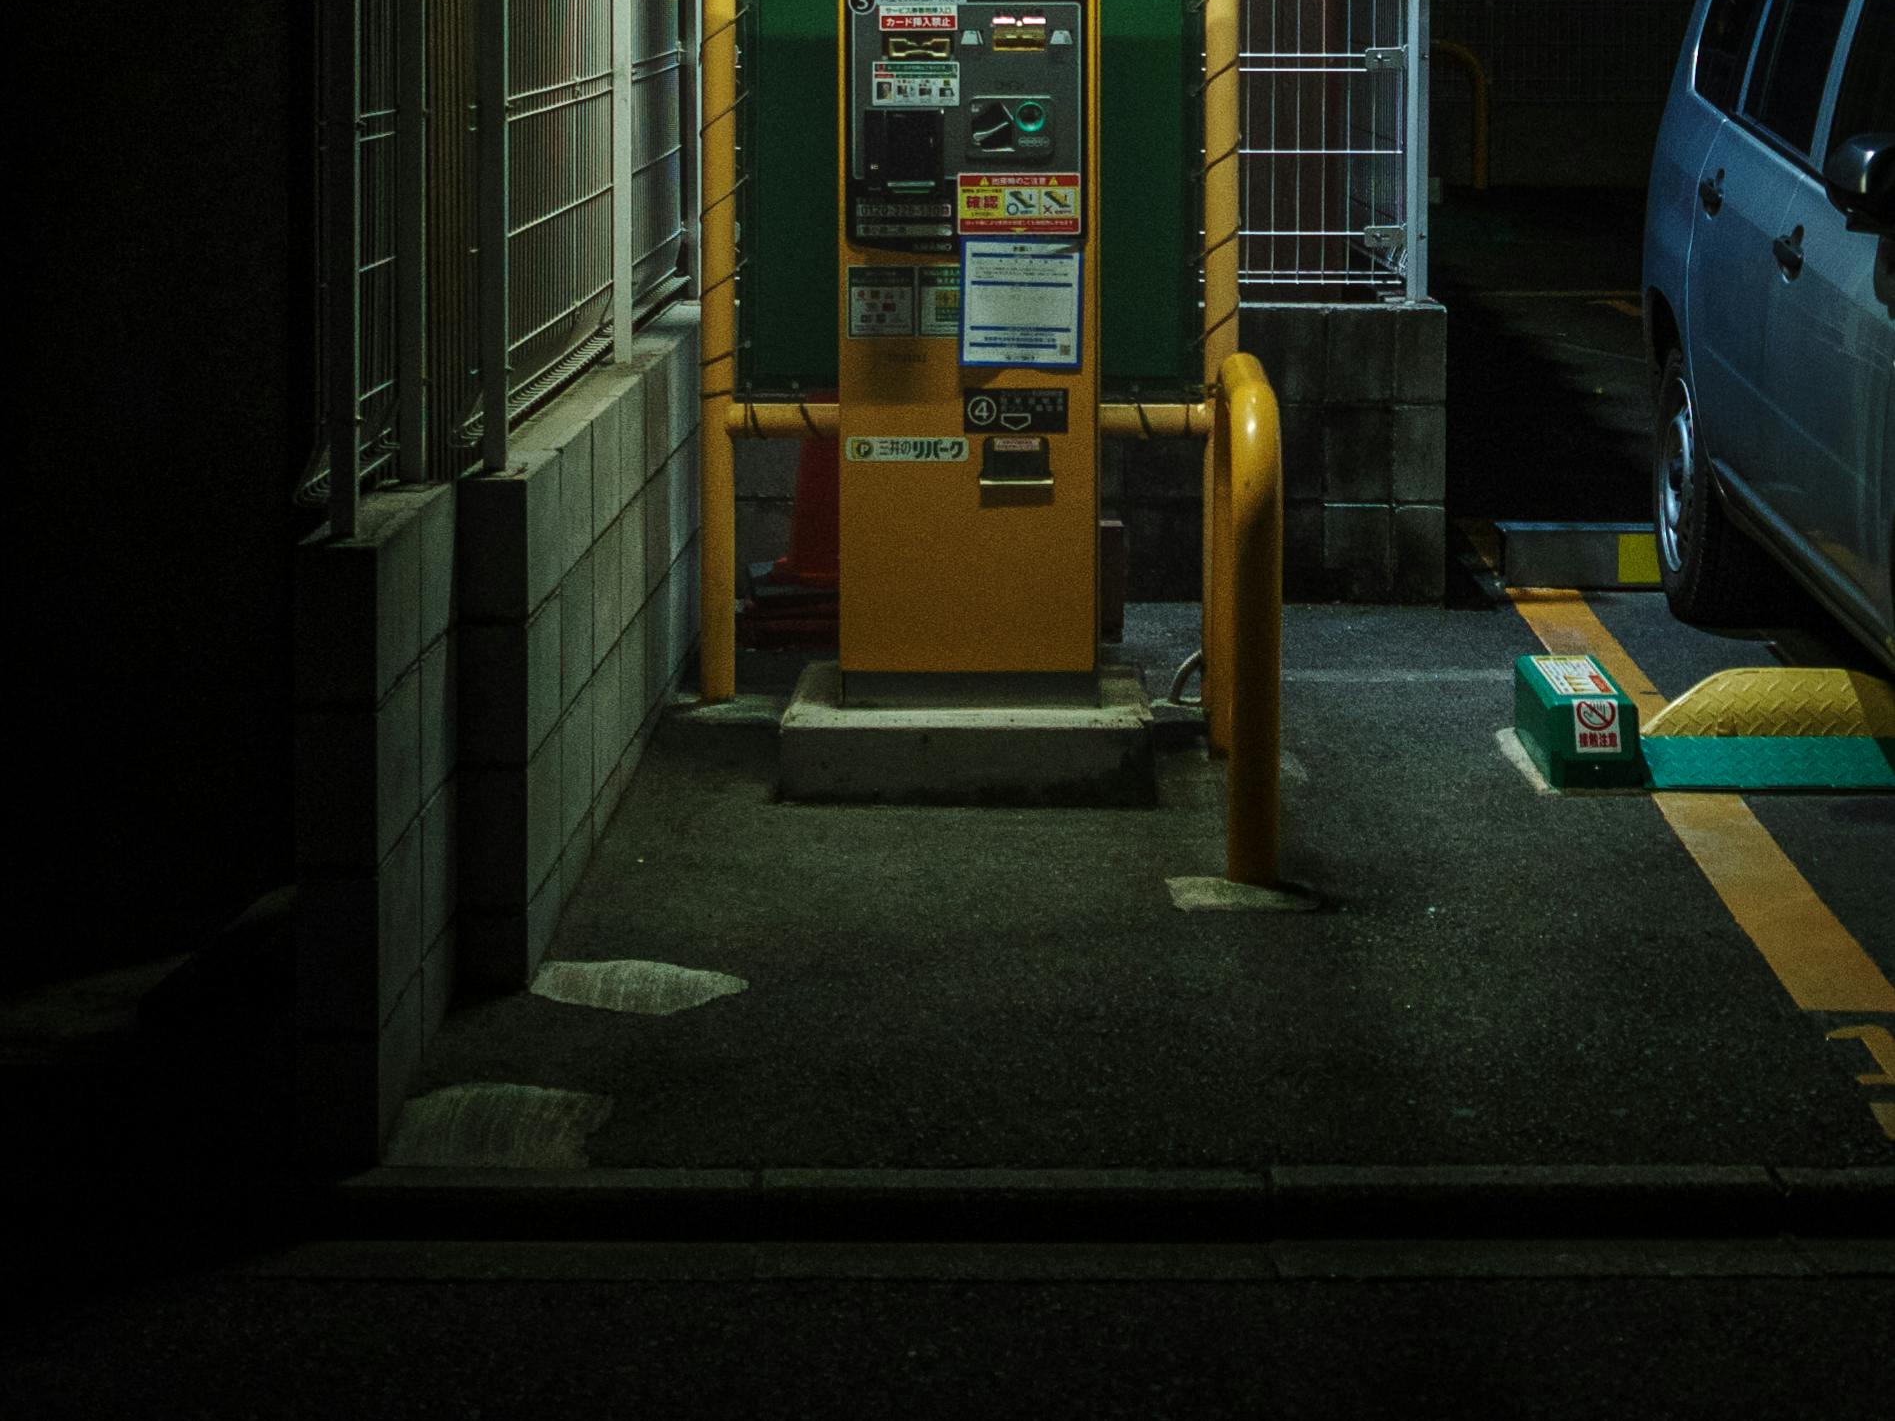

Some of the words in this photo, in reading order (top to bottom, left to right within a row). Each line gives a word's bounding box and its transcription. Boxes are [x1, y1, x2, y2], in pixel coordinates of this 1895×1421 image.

[886, 17, 951, 28] カード挿入禁止
[966, 195, 999, 210] 確認
[974, 402, 988, 419] 4
[878, 439, 964, 459] 三井のリパーク
